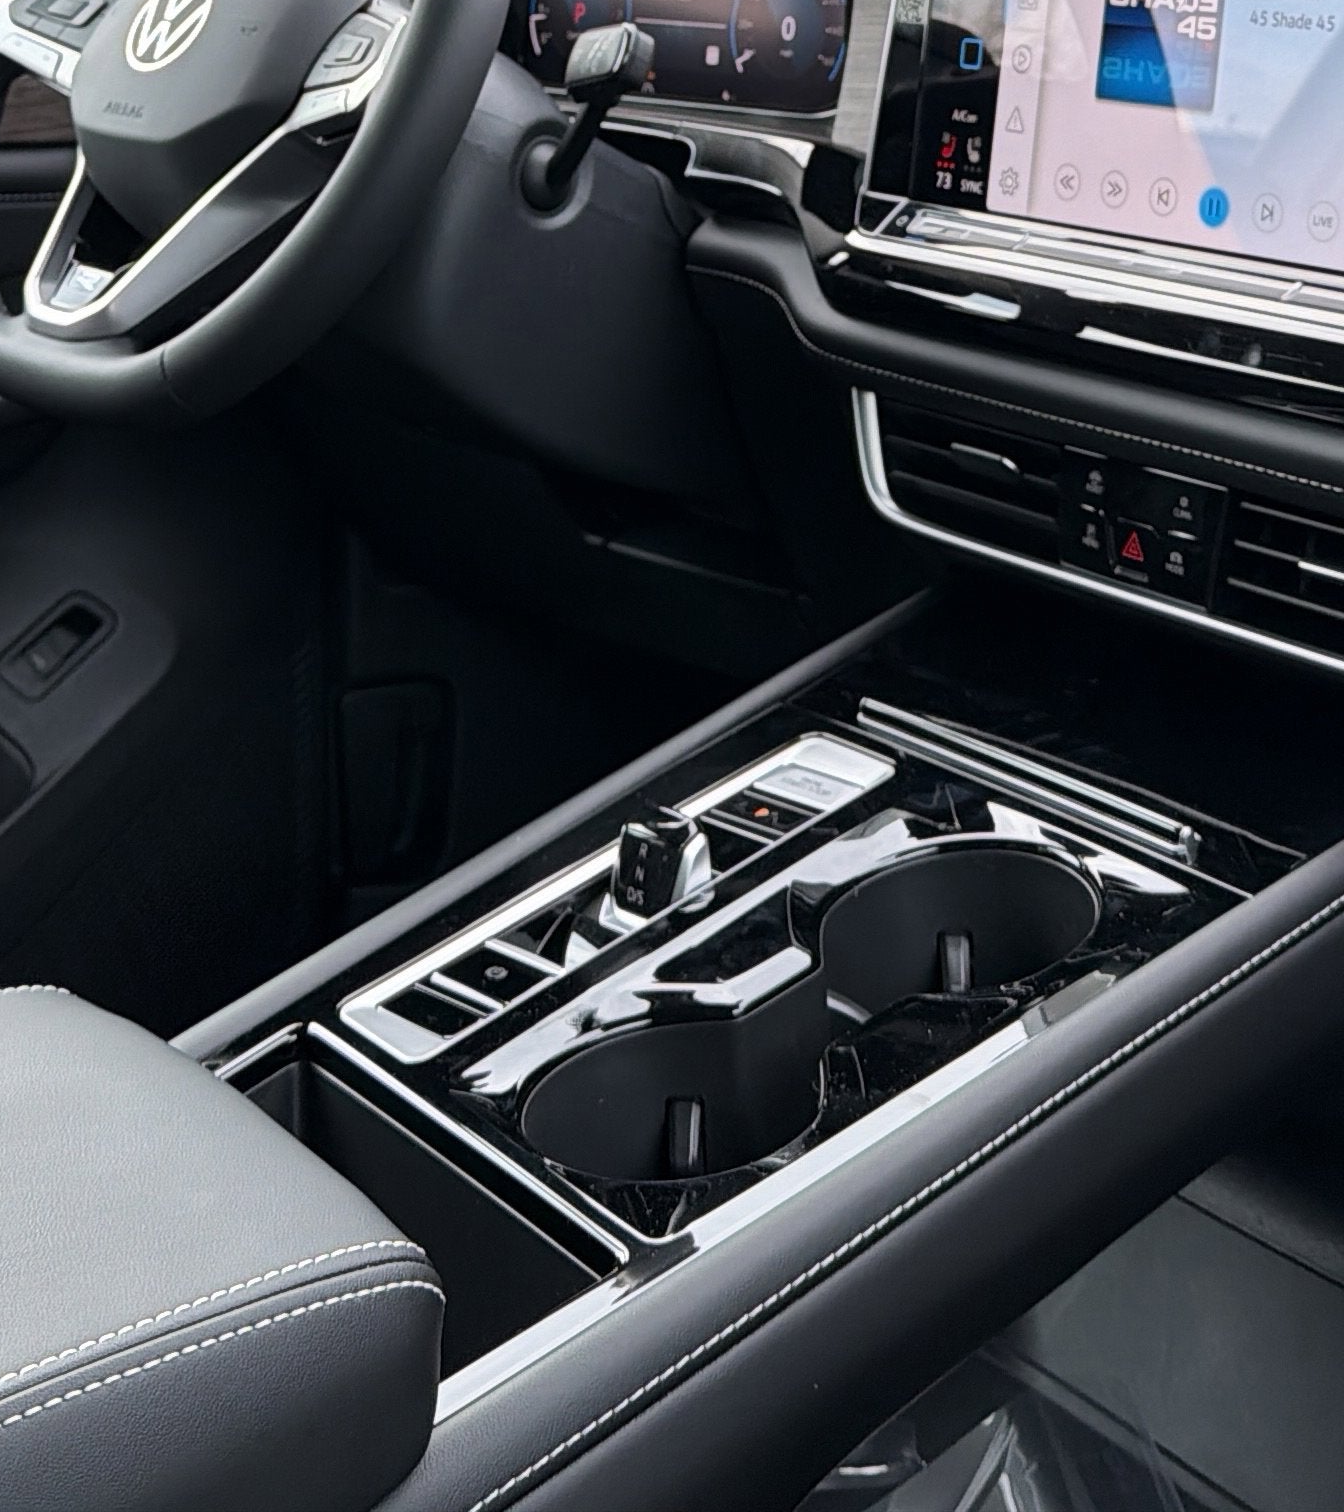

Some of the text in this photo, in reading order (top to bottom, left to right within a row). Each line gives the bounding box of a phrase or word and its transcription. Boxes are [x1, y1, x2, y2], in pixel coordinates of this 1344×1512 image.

[571, 0, 587, 25] P
[1249, 10, 1336, 33] 45 Shade 45
[781, 15, 797, 42] 0
[1176, 15, 1218, 40] 45
[935, 171, 953, 190] 73
[959, 178, 984, 196] SYNC
[1312, 214, 1334, 229] LIVE
[638, 842, 649, 859] R
[635, 865, 645, 882] N
